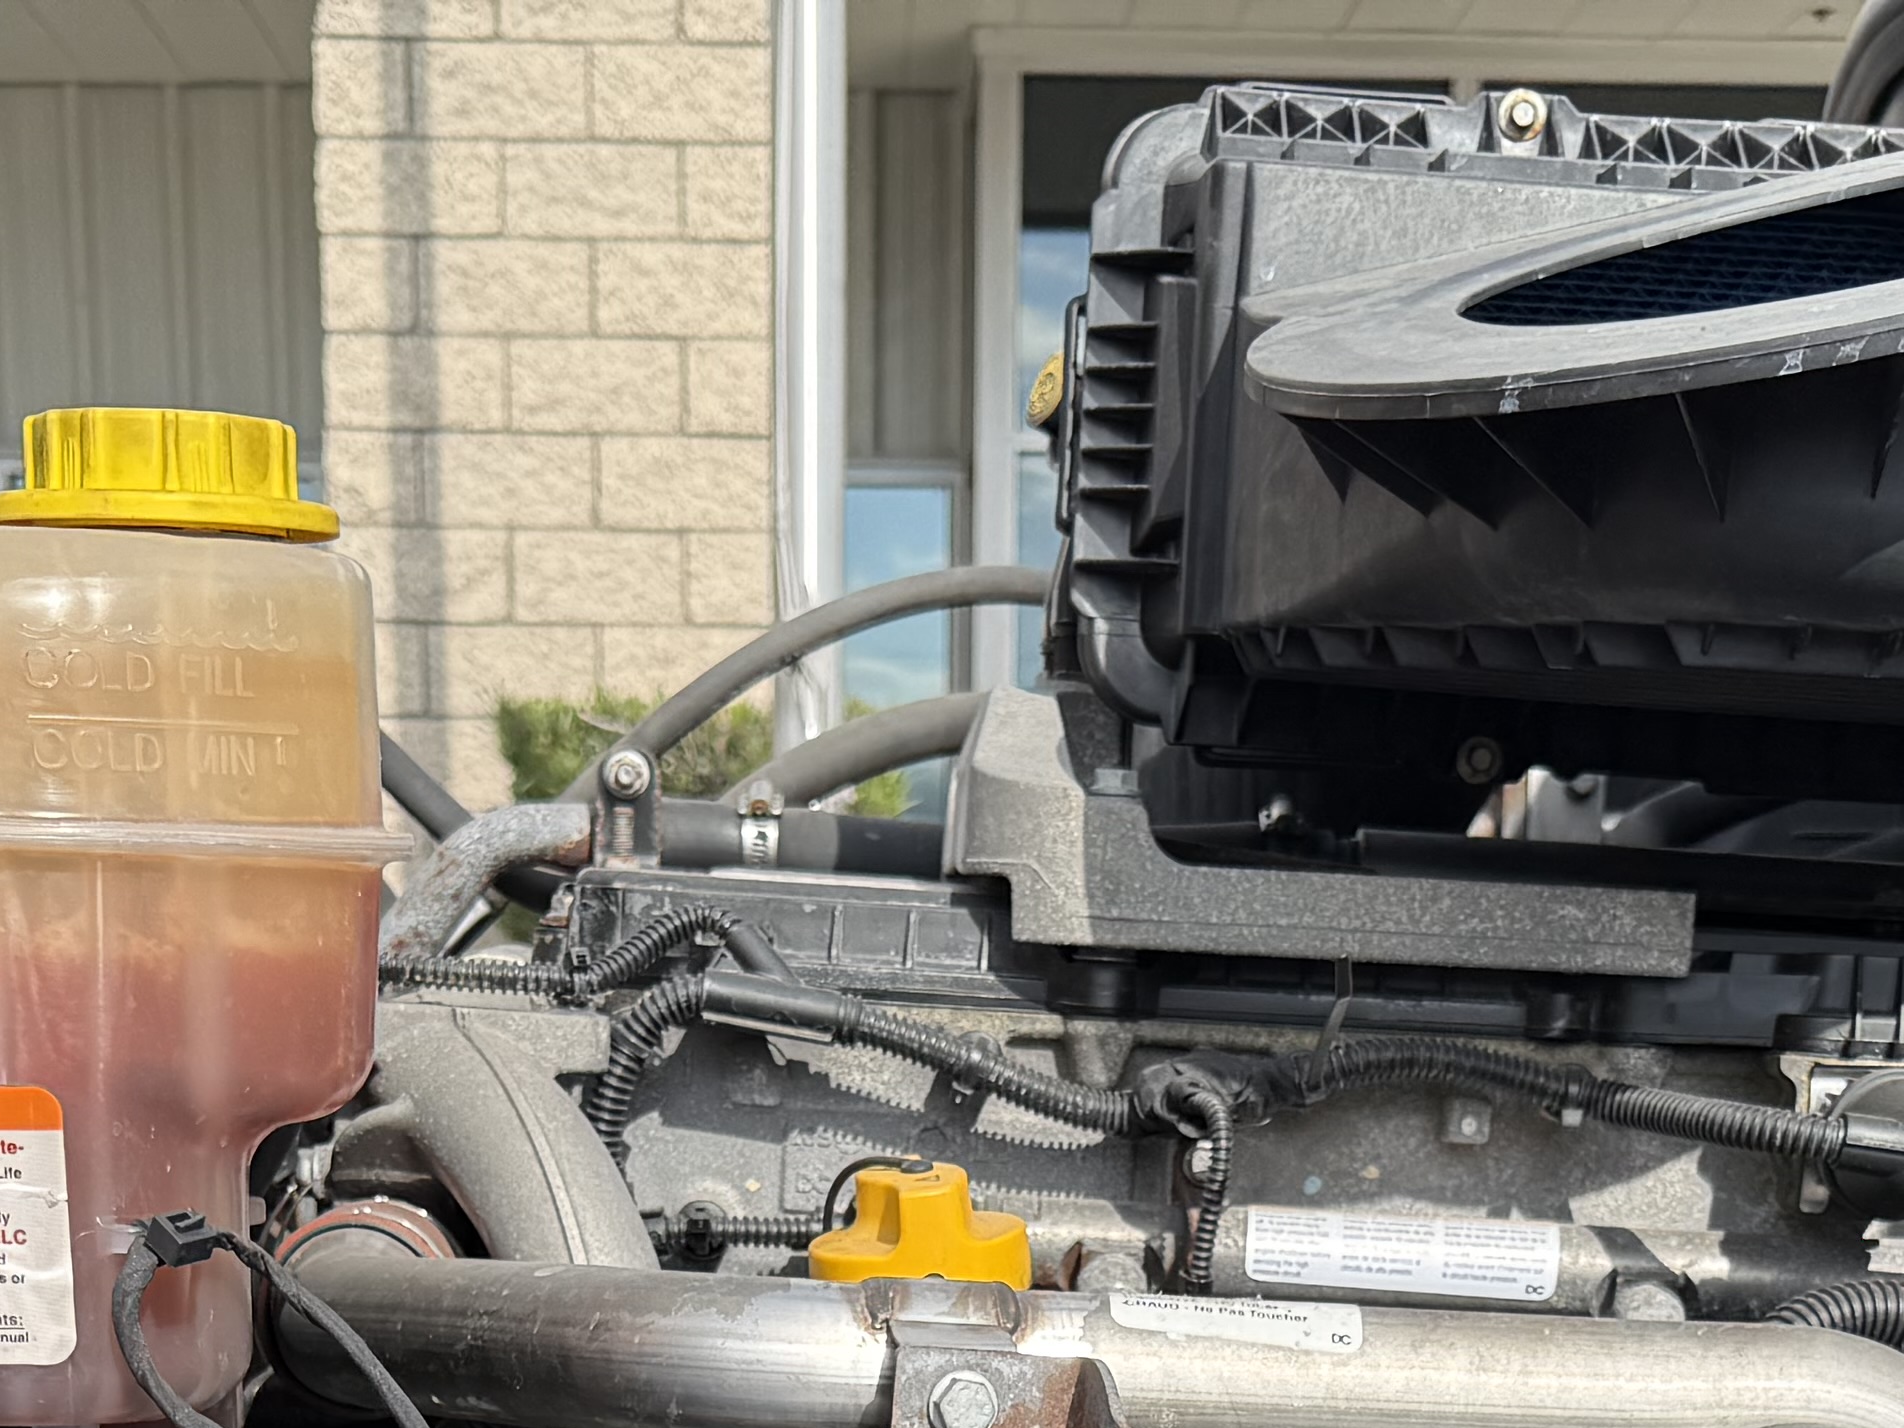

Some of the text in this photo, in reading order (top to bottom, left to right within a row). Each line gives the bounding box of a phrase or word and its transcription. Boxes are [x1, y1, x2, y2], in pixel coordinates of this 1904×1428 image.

[25, 646, 255, 698] COLD FILL
[33, 728, 256, 776] COLD MIN
[11, 1274, 25, 1284] or
